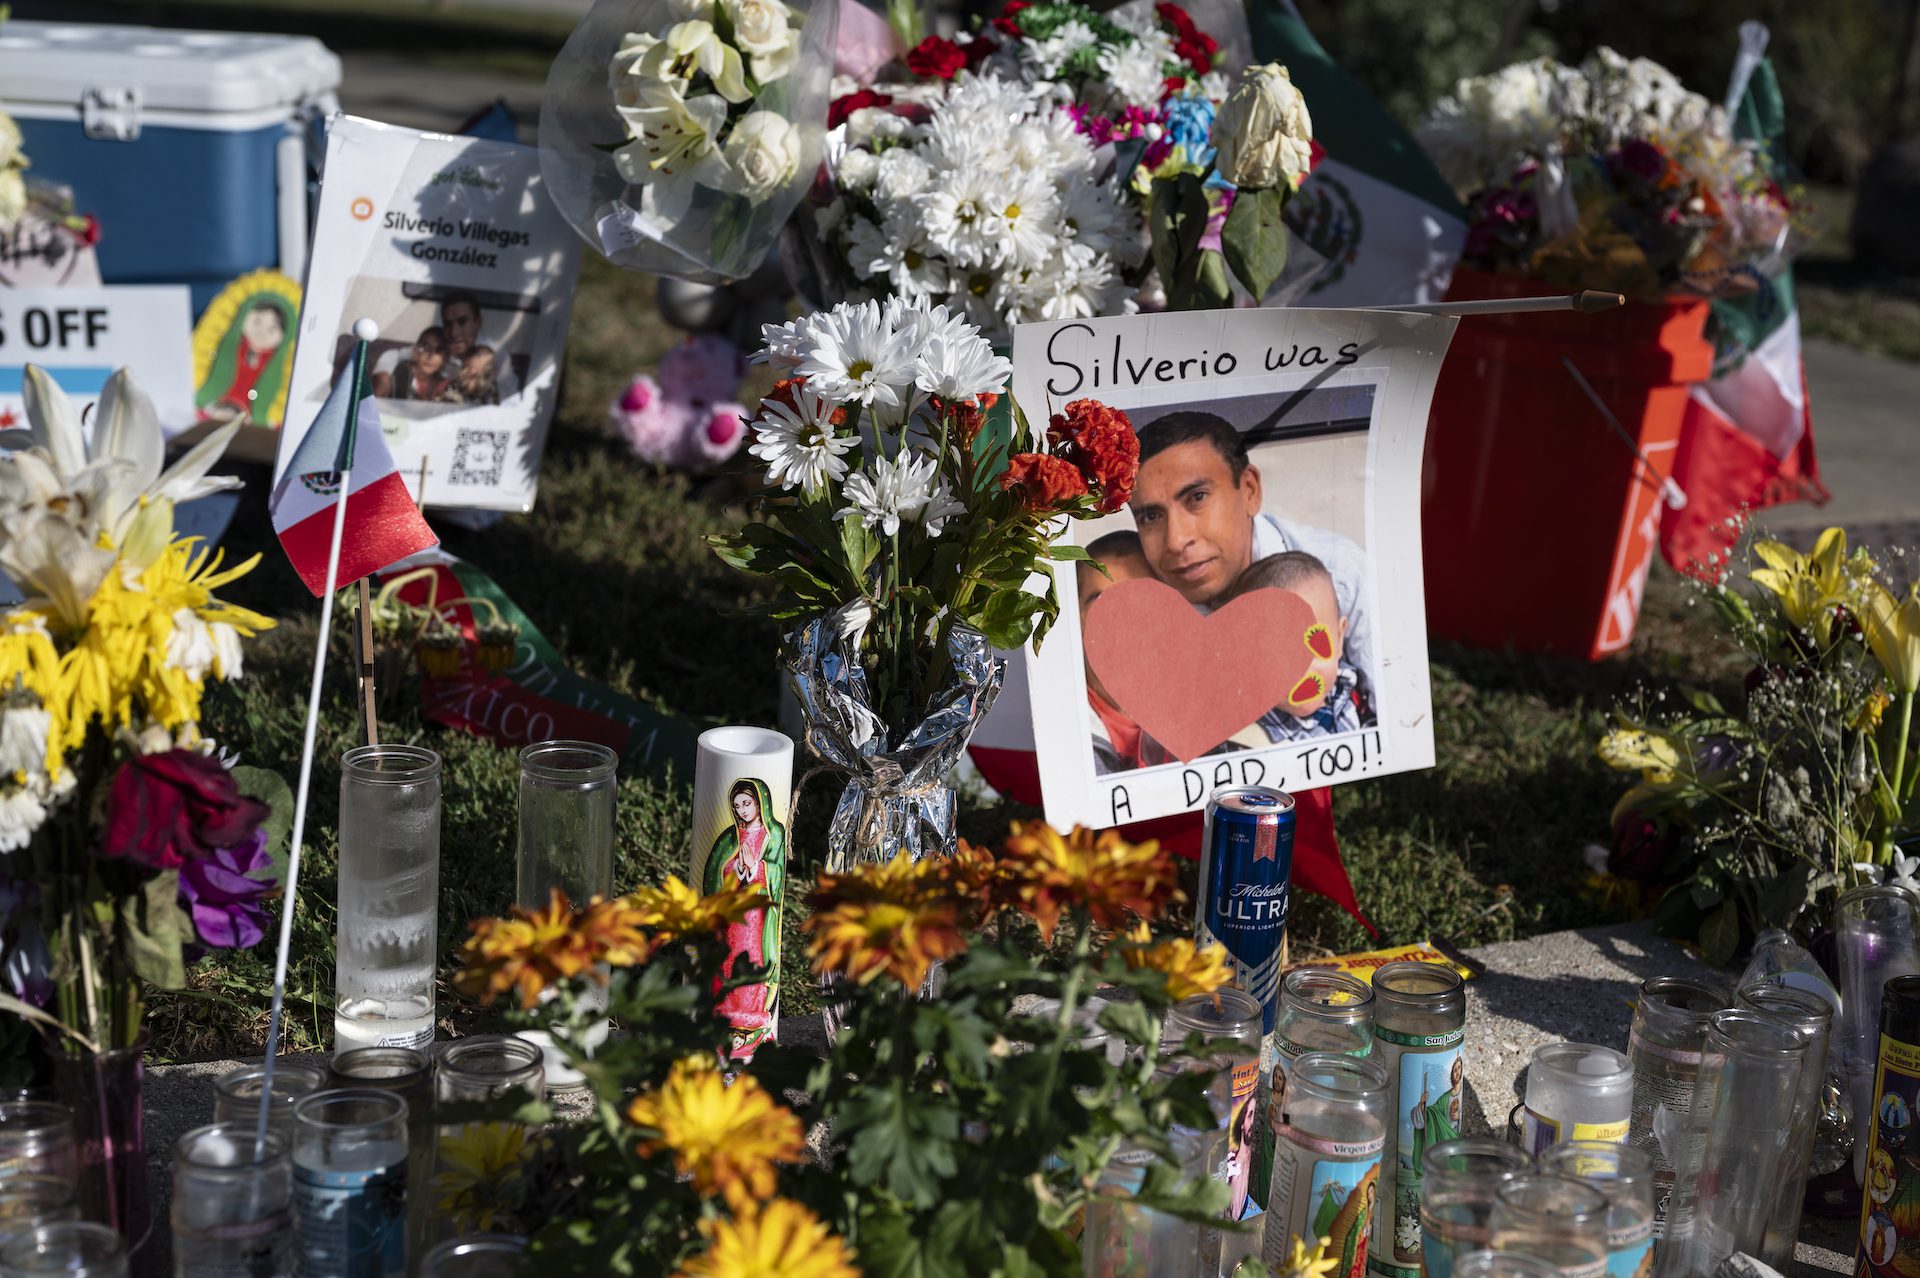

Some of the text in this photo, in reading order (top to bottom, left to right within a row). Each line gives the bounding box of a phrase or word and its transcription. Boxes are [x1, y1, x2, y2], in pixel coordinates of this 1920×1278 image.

[383, 211, 531, 248] Silverio Villegas
[410, 240, 499, 269] González
[24, 307, 109, 349] OFF
[1047, 323, 1360, 397] Silverio was
[1111, 784, 1133, 825] A
[1297, 730, 1383, 781] TOO!!
[1229, 880, 1287, 898] Michelob
[1216, 894, 1289, 920] ULTRA
[1223, 921, 1256, 931] SUPERIOR
[1258, 923, 1275, 931] LIGHT
[1333, 1144, 1366, 1154] Virgen
